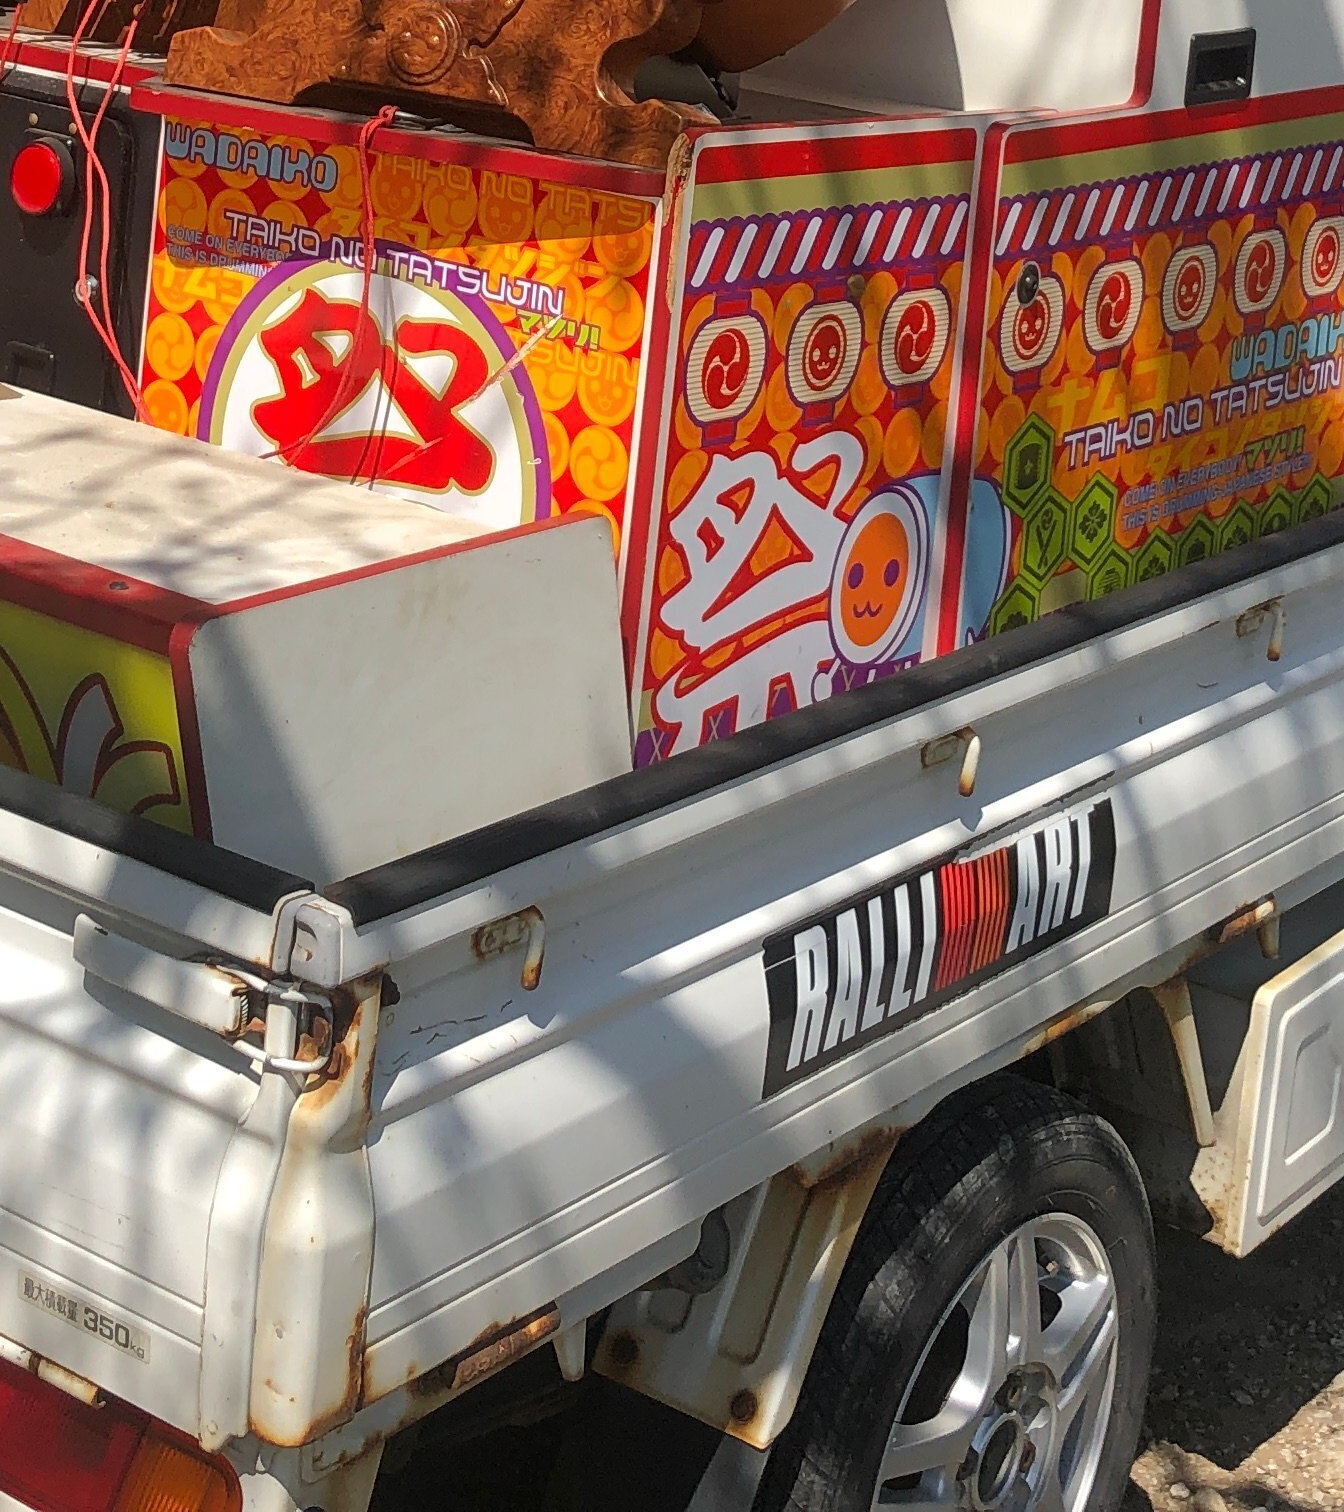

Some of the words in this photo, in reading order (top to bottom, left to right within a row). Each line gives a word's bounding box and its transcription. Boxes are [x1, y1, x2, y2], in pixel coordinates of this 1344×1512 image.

[165, 121, 338, 193] WADAIKO
[166, 242, 194, 261] THIS
[194, 250, 208, 264] IS
[167, 224, 203, 245] COME
[205, 234, 223, 250] ON
[224, 209, 320, 257] TAIKO
[385, 246, 566, 316] TATSUJIN
[1063, 408, 1155, 468] TAIKO
[1161, 397, 1203, 439] NO
[1210, 356, 1344, 423] TATSUJIN
[785, 870, 937, 1072] RALLI
[1005, 805, 1096, 956] ART
[23, 1277, 79, 1322] 最大積載量
